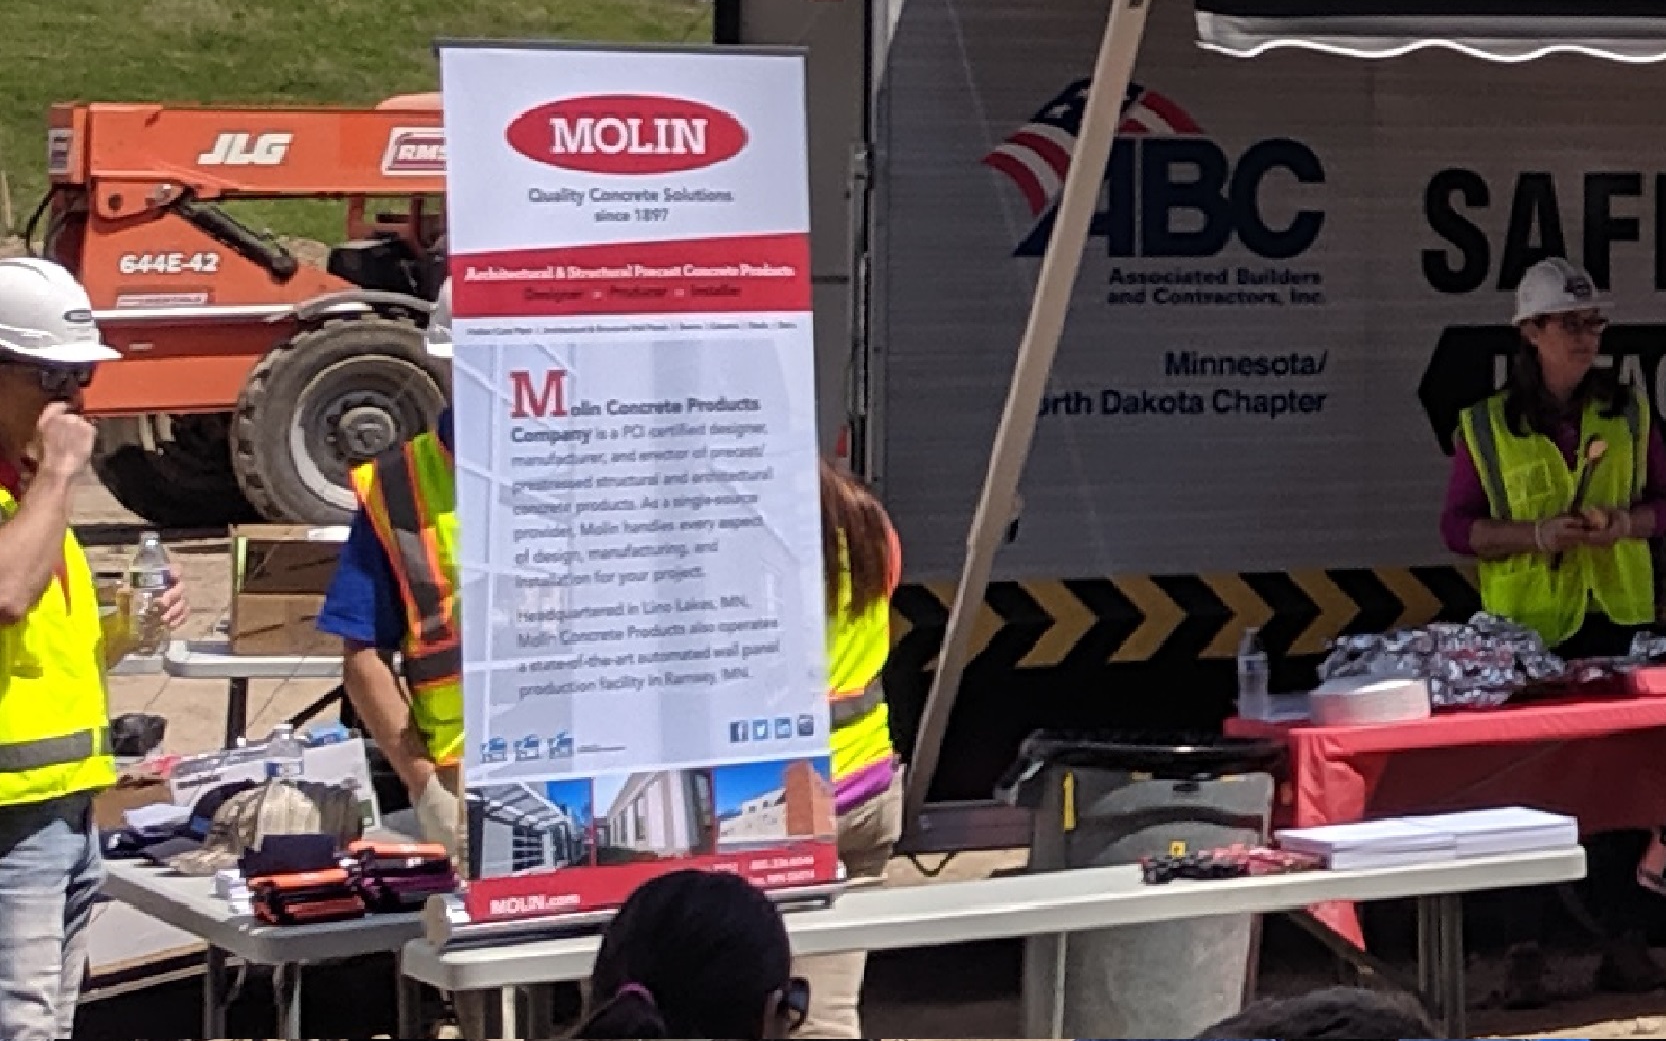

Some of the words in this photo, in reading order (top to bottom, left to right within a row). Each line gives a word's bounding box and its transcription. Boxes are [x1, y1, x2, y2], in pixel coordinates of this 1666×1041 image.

[550, 117, 708, 154] MOLIN
[197, 132, 294, 166] JLG
[528, 188, 585, 206] Quality
[589, 188, 658, 202] Concrete
[1012, 137, 1325, 259] ABC
[595, 209, 630, 222] since
[634, 209, 668, 221] 1897
[120, 252, 219, 274] 644E-42
[1109, 268, 1227, 285] Associated
[1237, 268, 1321, 285] Builders
[1108, 288, 1145, 304] and
[1166, 350, 1328, 376] Minnesota/
[607, 399, 682, 414] Concrete
[687, 396, 761, 413] Products
[1039, 391, 1093, 416] orth
[1102, 390, 1203, 415] Dakota
[1213, 390, 1327, 418] Chapter
[511, 426, 591, 444] Company
